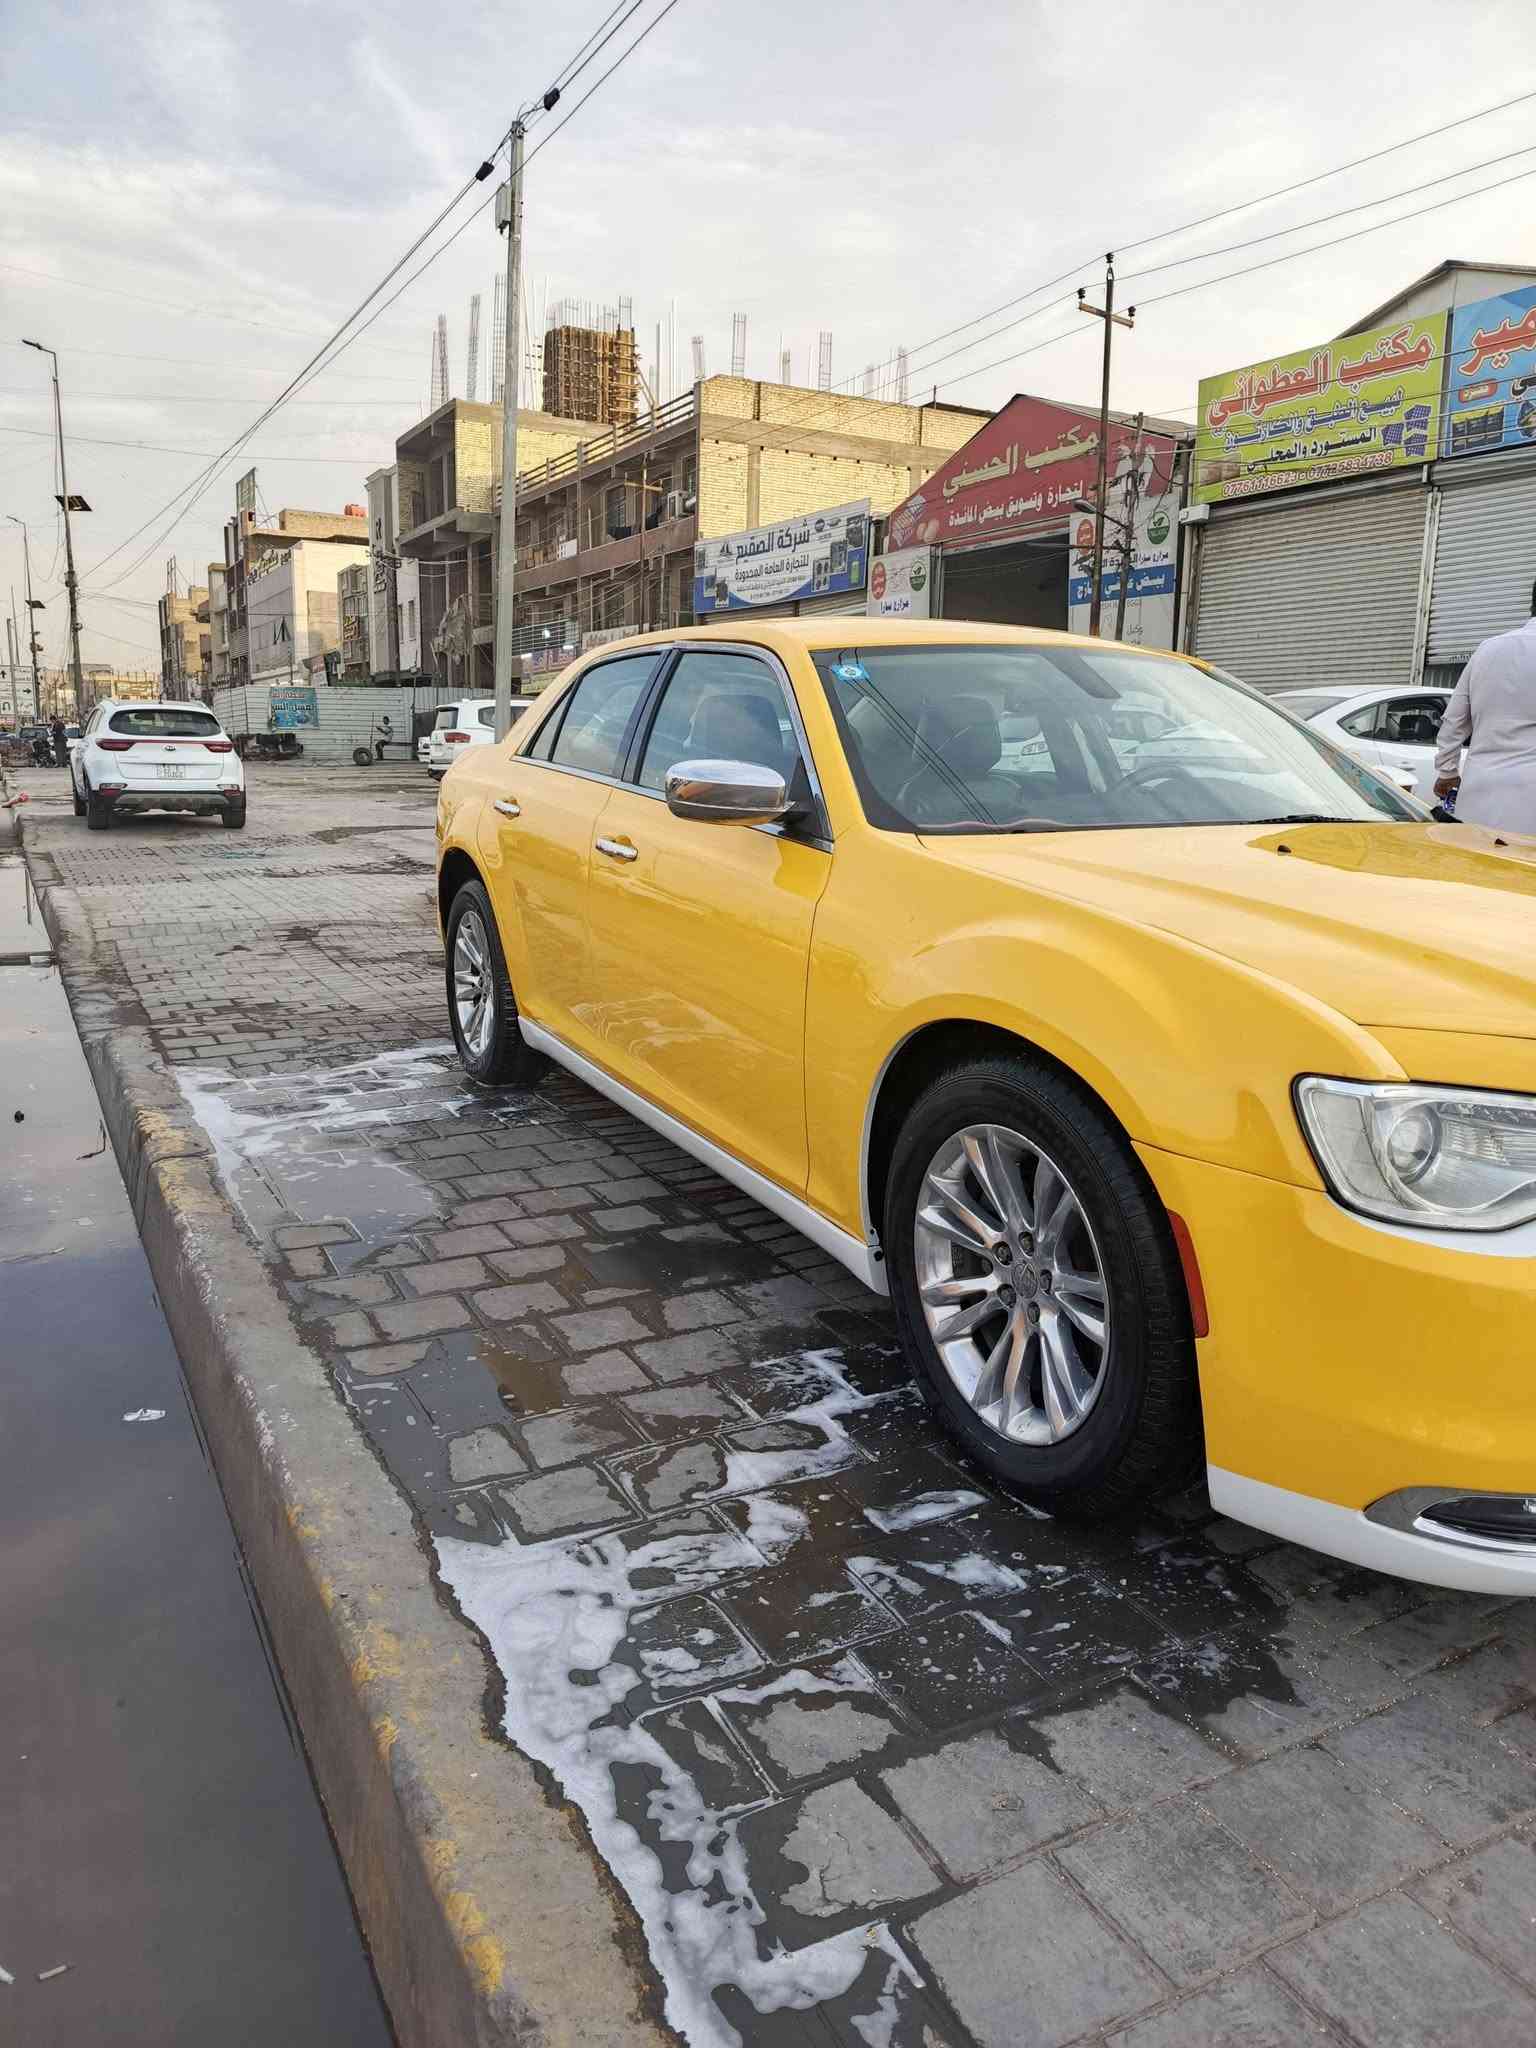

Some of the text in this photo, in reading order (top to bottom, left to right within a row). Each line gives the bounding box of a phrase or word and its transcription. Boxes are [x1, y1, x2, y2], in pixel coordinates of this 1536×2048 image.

[1337, 322, 1434, 393] مكتب
[942, 424, 1099, 503] مكتب الحسني
[777, 519, 810, 553] شركة
